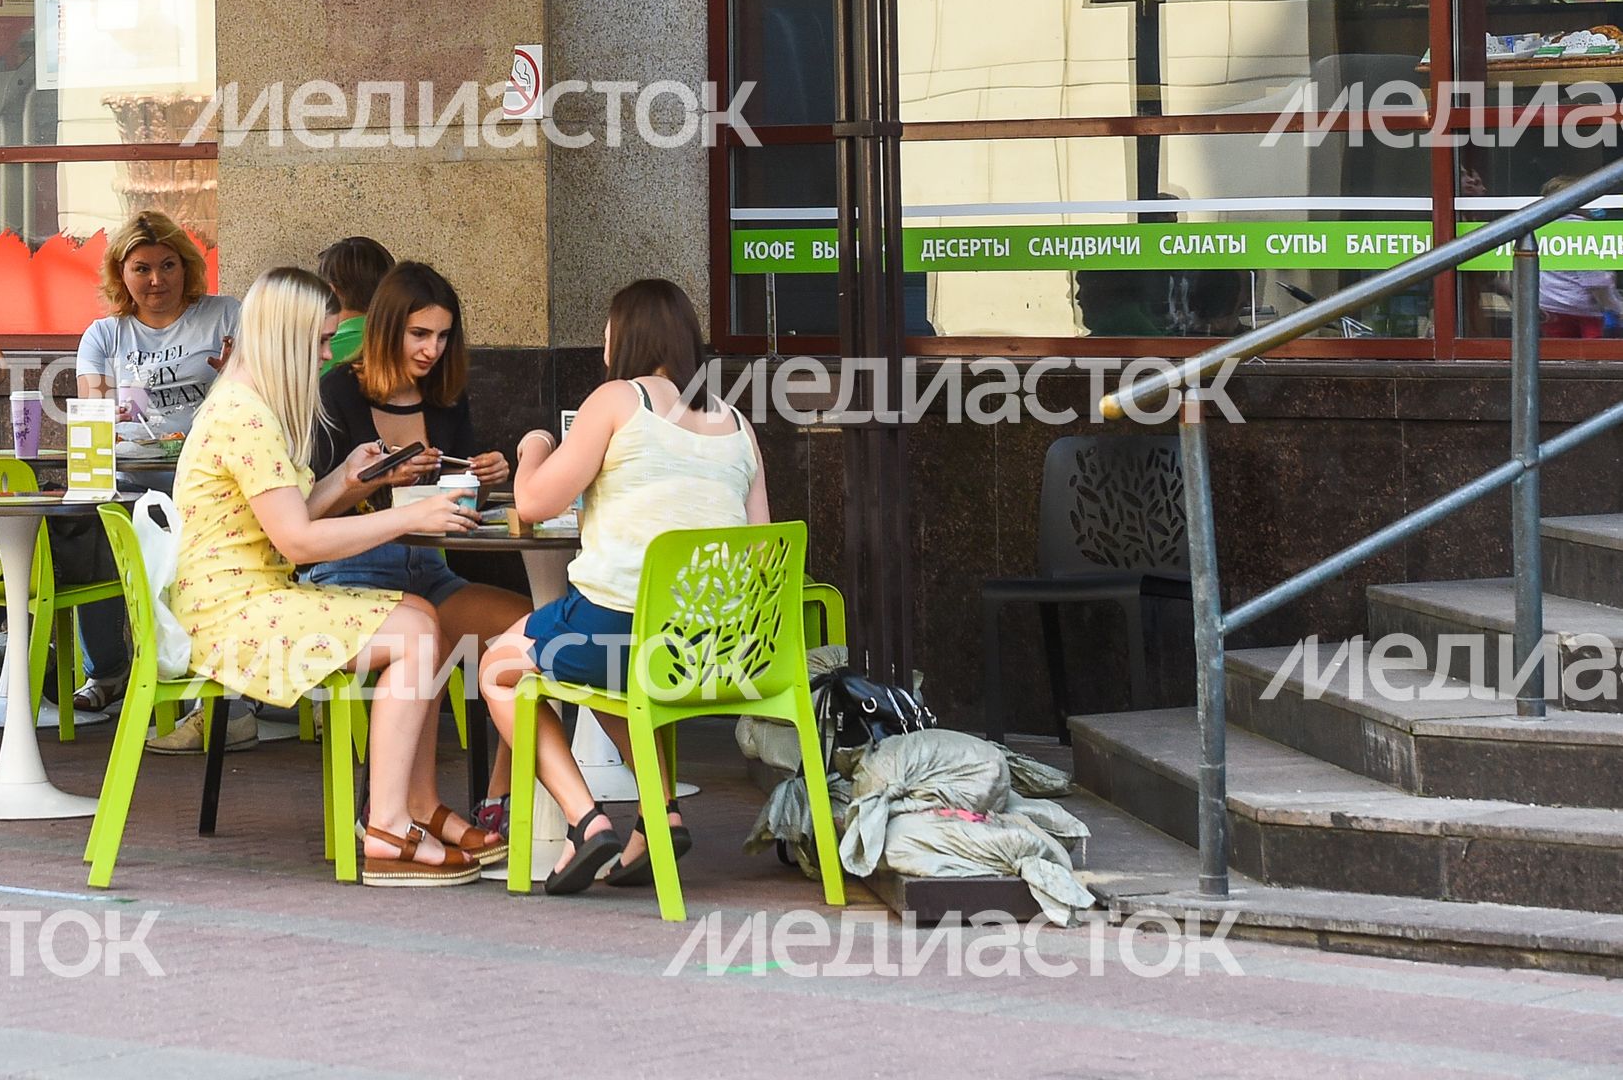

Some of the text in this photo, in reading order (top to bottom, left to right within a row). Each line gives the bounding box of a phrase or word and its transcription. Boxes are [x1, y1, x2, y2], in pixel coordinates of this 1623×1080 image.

[743, 239, 795, 261] КОФЕ
[921, 233, 1431, 262] ДЕСЕРТЫ САНДВИЧИ САЛАТЫ СУПЫ БАГЕТЫ
[138, 345, 189, 366] FEEL
